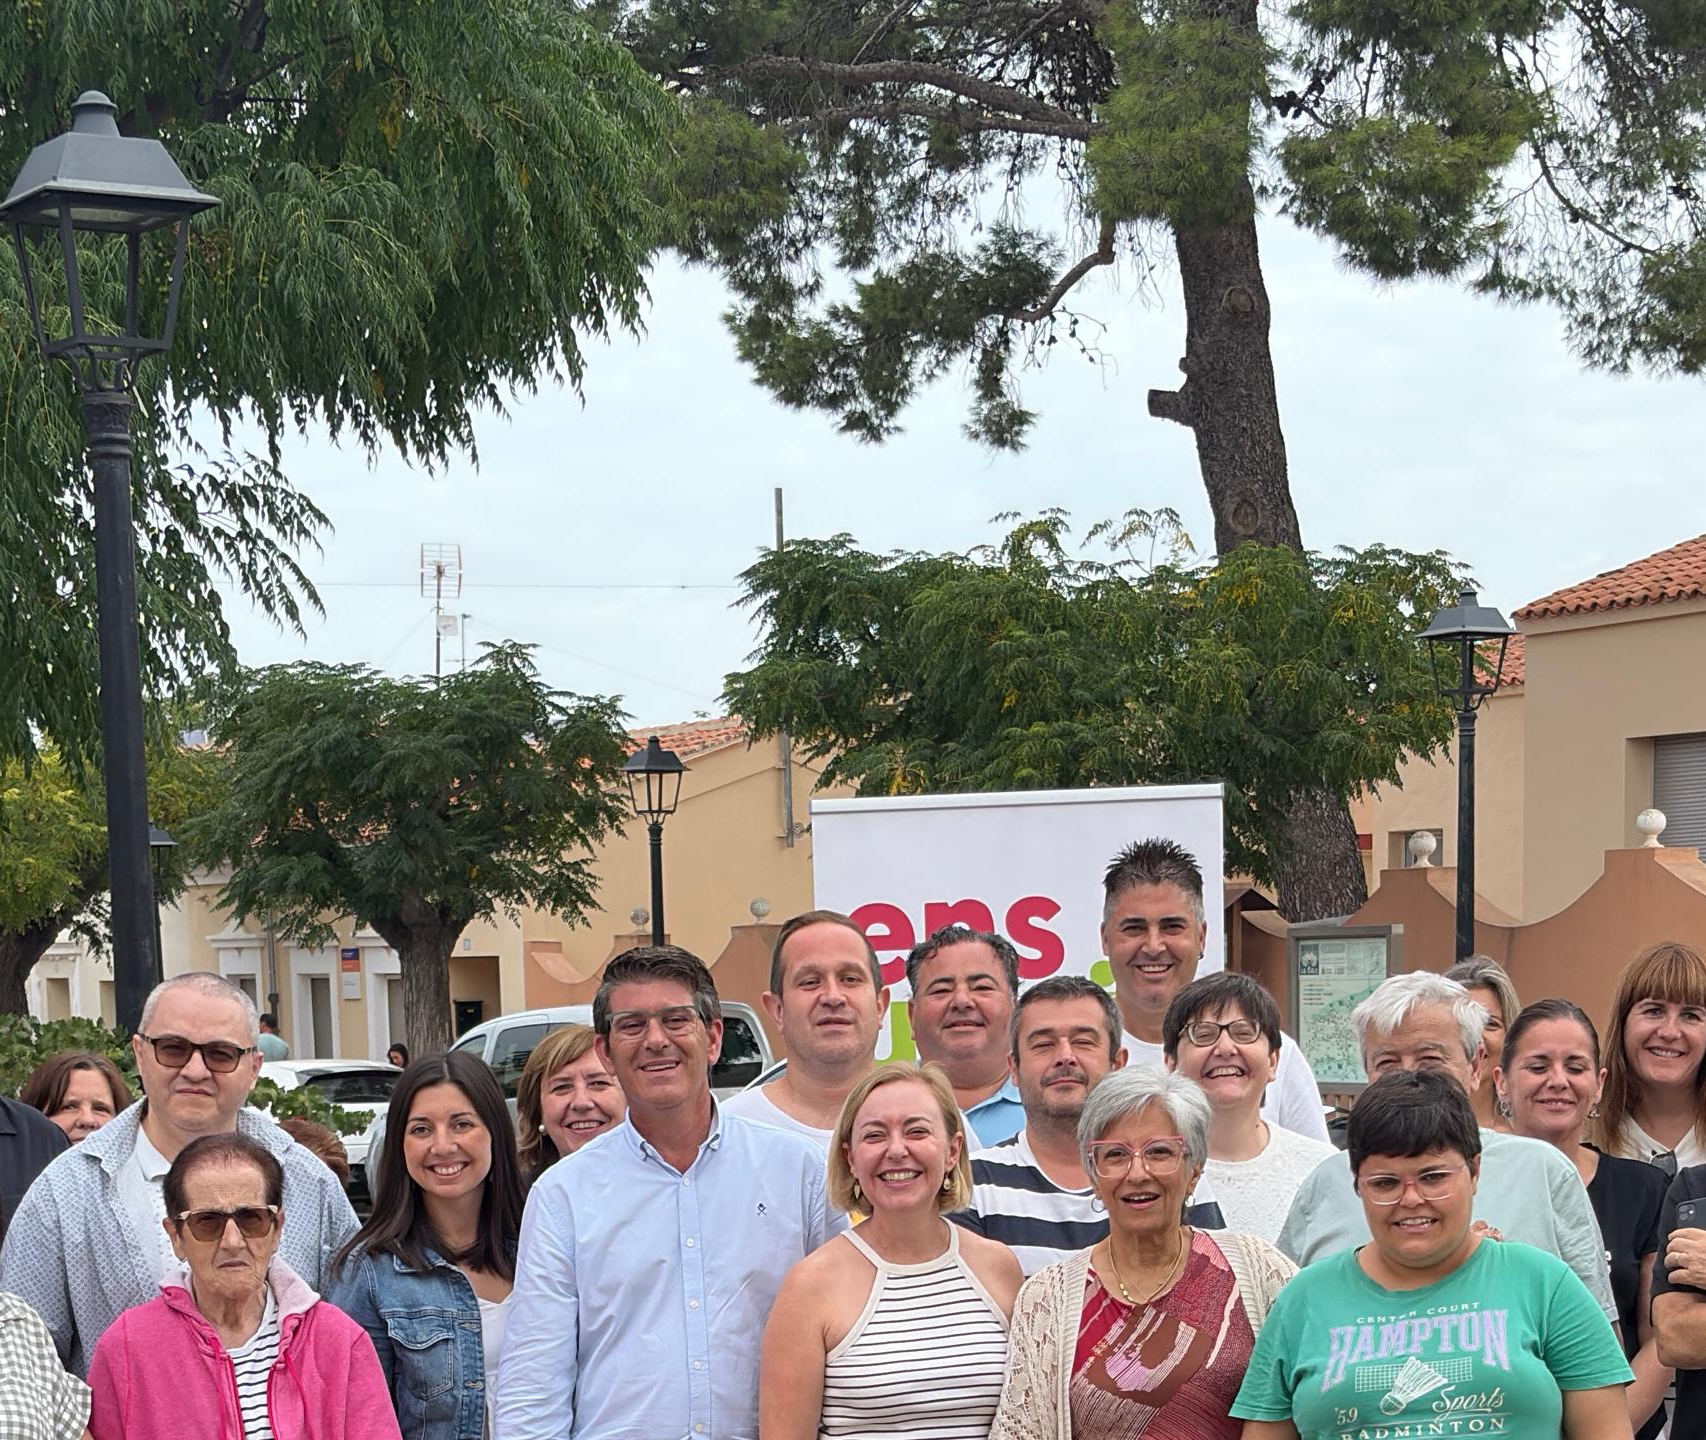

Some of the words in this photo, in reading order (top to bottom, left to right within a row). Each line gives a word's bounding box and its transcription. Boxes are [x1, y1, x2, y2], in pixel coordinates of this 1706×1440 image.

[1426, 1302, 1480, 1315] COURT
[1321, 1309, 1510, 1392] HAMPTON
[1432, 1386, 1506, 1424] Sports
